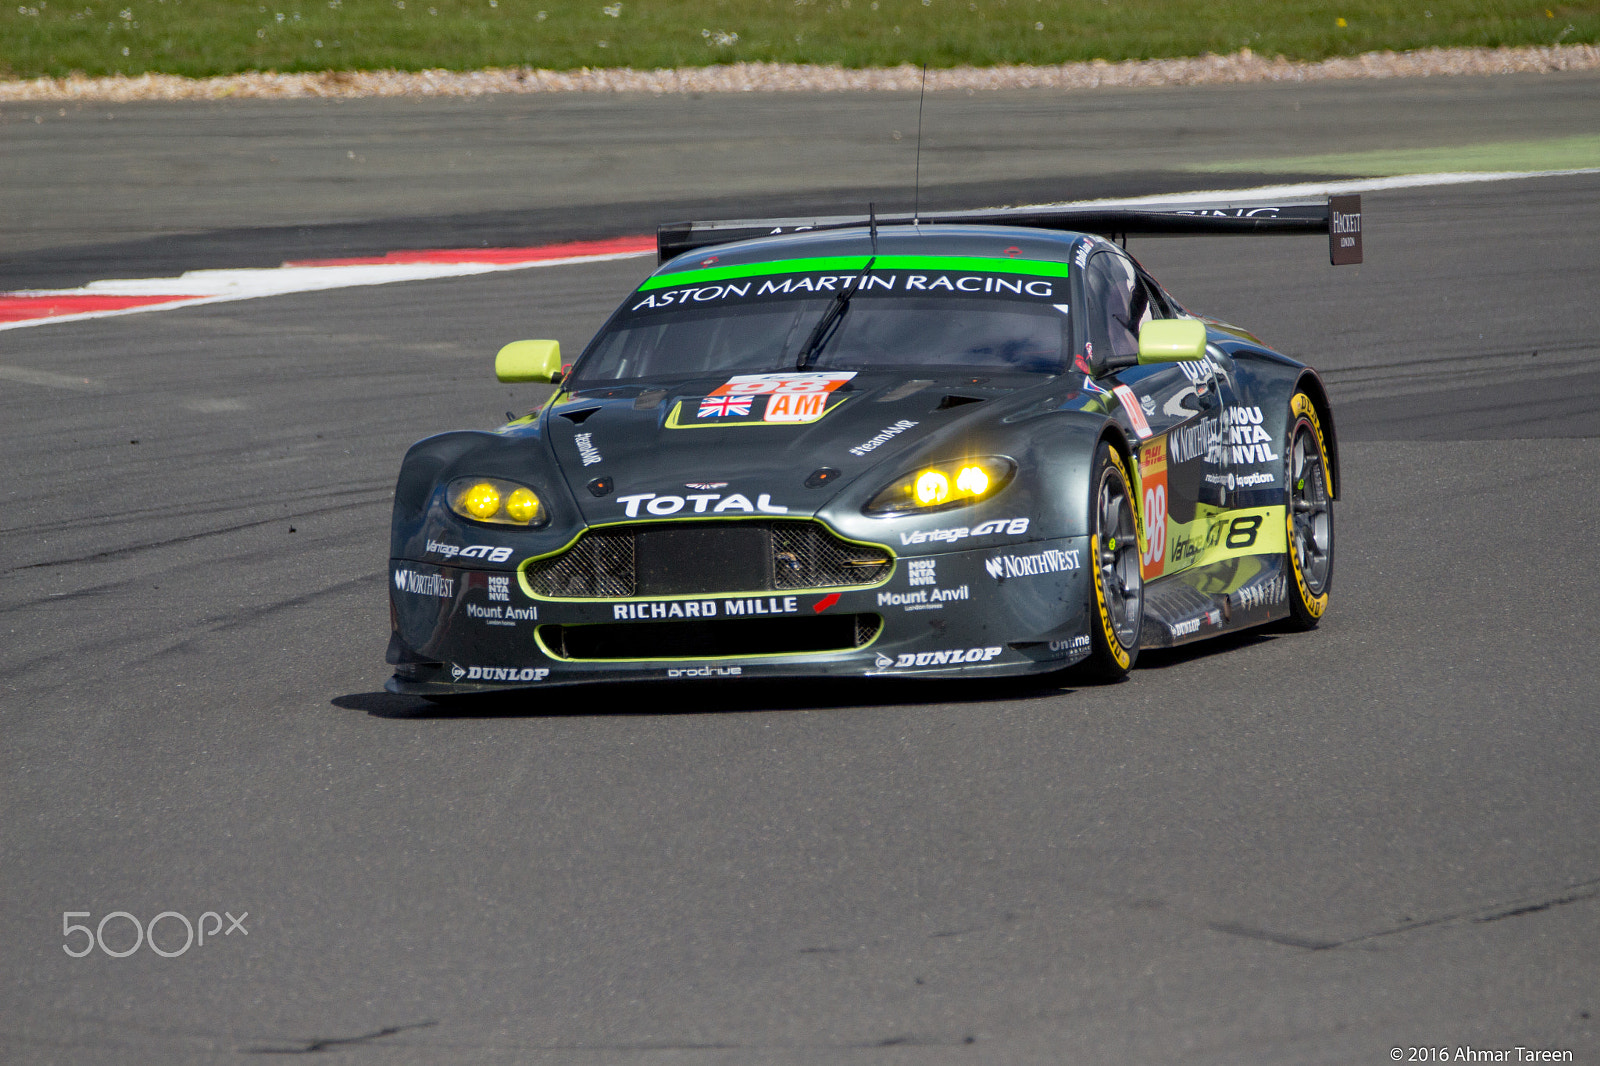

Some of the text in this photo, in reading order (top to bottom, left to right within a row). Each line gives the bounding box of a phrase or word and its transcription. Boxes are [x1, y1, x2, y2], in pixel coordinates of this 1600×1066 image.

[1333, 211, 1361, 233] HACKETT
[632, 275, 1053, 311] ASTON MARTIN RACING
[726, 379, 830, 395] 98
[770, 395, 821, 416] AM
[1229, 406, 1264, 425] MOU
[849, 420, 920, 457] #teamAMR
[1230, 425, 1273, 445] NTA
[1232, 443, 1279, 464] NVIL
[616, 493, 788, 518] TOTAL
[900, 518, 1030, 546] Vantage GT8
[1143, 484, 1165, 567] 98
[426, 539, 514, 562] Vantage GT8
[908, 560, 936, 570] MOU
[909, 569, 937, 578] NTA
[488, 576, 509, 586] MOU
[488, 585, 509, 594] NTA
[910, 577, 937, 586] NVIL
[489, 593, 510, 601] NVIL
[877, 585, 969, 607] Mount Anvil
[467, 604, 538, 620] Mount Anvil
[613, 596, 798, 620] RICHARD MILLE
[895, 647, 1002, 668] DUNLOP
[467, 666, 550, 681] DUNLOP
[668, 666, 742, 677] prodrive
